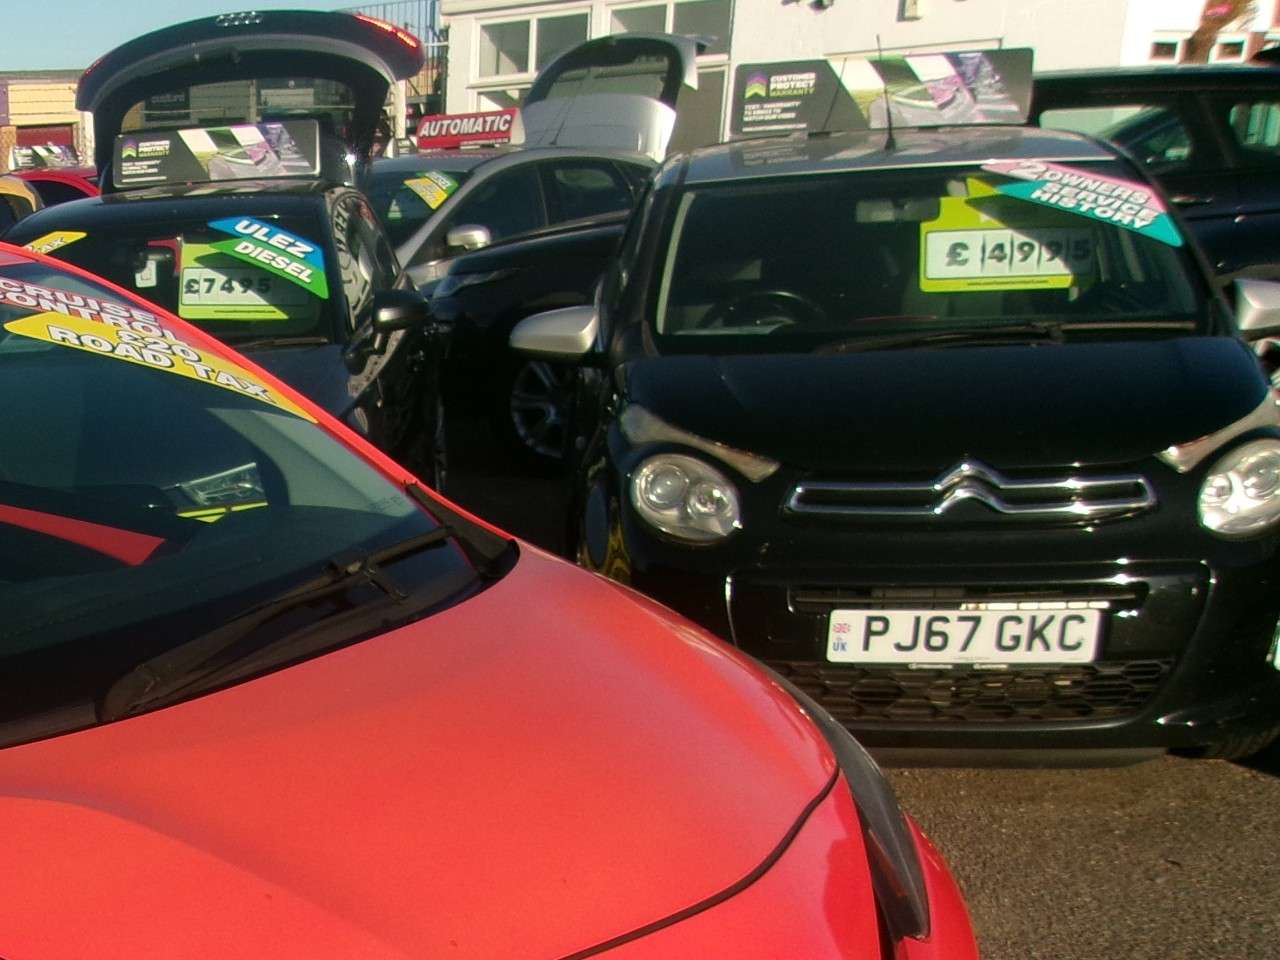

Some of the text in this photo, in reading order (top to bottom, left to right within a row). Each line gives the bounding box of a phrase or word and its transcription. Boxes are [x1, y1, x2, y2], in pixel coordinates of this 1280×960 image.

[420, 114, 512, 137] AUTOMATIC
[1007, 160, 1151, 206] 2 OWNERS
[1038, 182, 1159, 221] SERVICE
[1030, 190, 1153, 229] HISTORY
[233, 219, 314, 259] ULEZ
[233, 241, 313, 284] DIESEL
[183, 277, 271, 296] £7495
[47, 325, 280, 404] ROAD TAX
[115, 329, 202, 363] £20
[832, 641, 848, 653] UK
[862, 614, 1087, 653] PJ67 GKC
